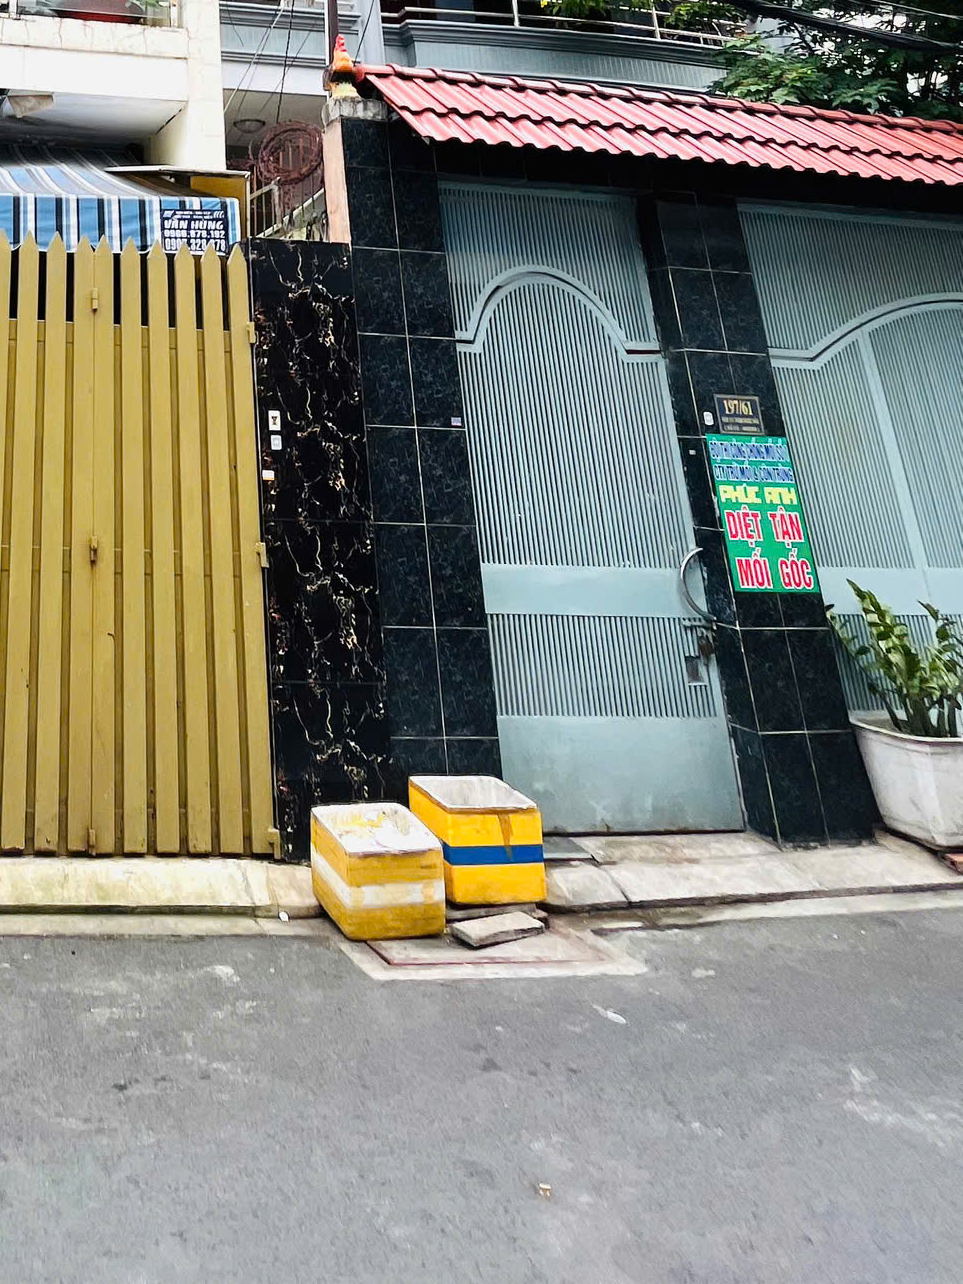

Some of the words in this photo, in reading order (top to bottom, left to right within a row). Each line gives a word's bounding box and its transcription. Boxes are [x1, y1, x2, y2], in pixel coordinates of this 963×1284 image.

[723, 399, 753, 416] 197/61
[718, 483, 762, 504] PHÚC
[764, 486, 798, 505] ANH
[725, 505, 764, 549] DIỆT
[769, 506, 805, 547] TẬN
[736, 548, 774, 589] MỐI
[779, 549, 814, 590] GỐC
